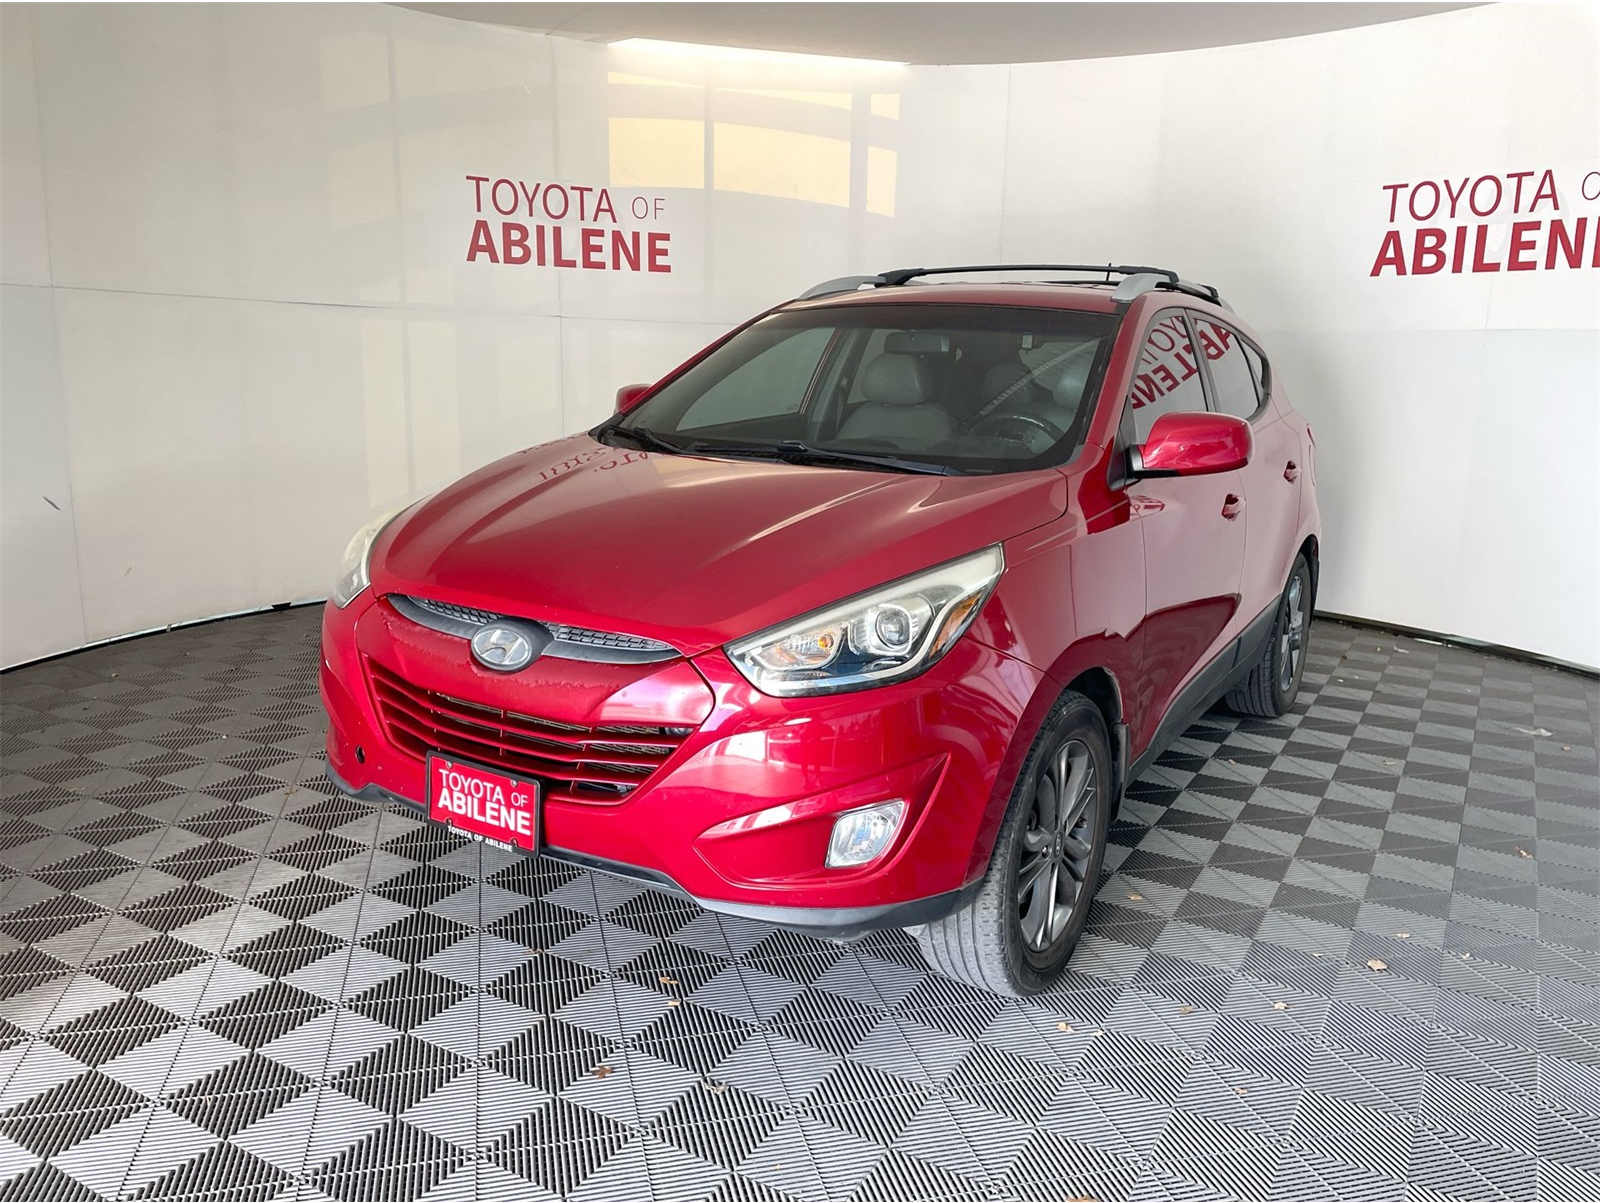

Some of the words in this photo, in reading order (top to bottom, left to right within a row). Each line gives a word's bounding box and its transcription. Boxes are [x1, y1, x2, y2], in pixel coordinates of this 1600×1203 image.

[465, 175, 618, 224] TOYOTA
[631, 196, 666, 221] OF
[1382, 169, 1560, 223] TOYOTA
[466, 219, 672, 273] ABILENE
[1369, 216, 1600, 277] ABILEN
[438, 768, 505, 805] TOYOTA
[510, 792, 529, 808] OF
[438, 787, 532, 836] ABILENE
[447, 825, 472, 840] TOYOTA
[473, 834, 484, 842] OF
[484, 837, 513, 853] ABILENE
